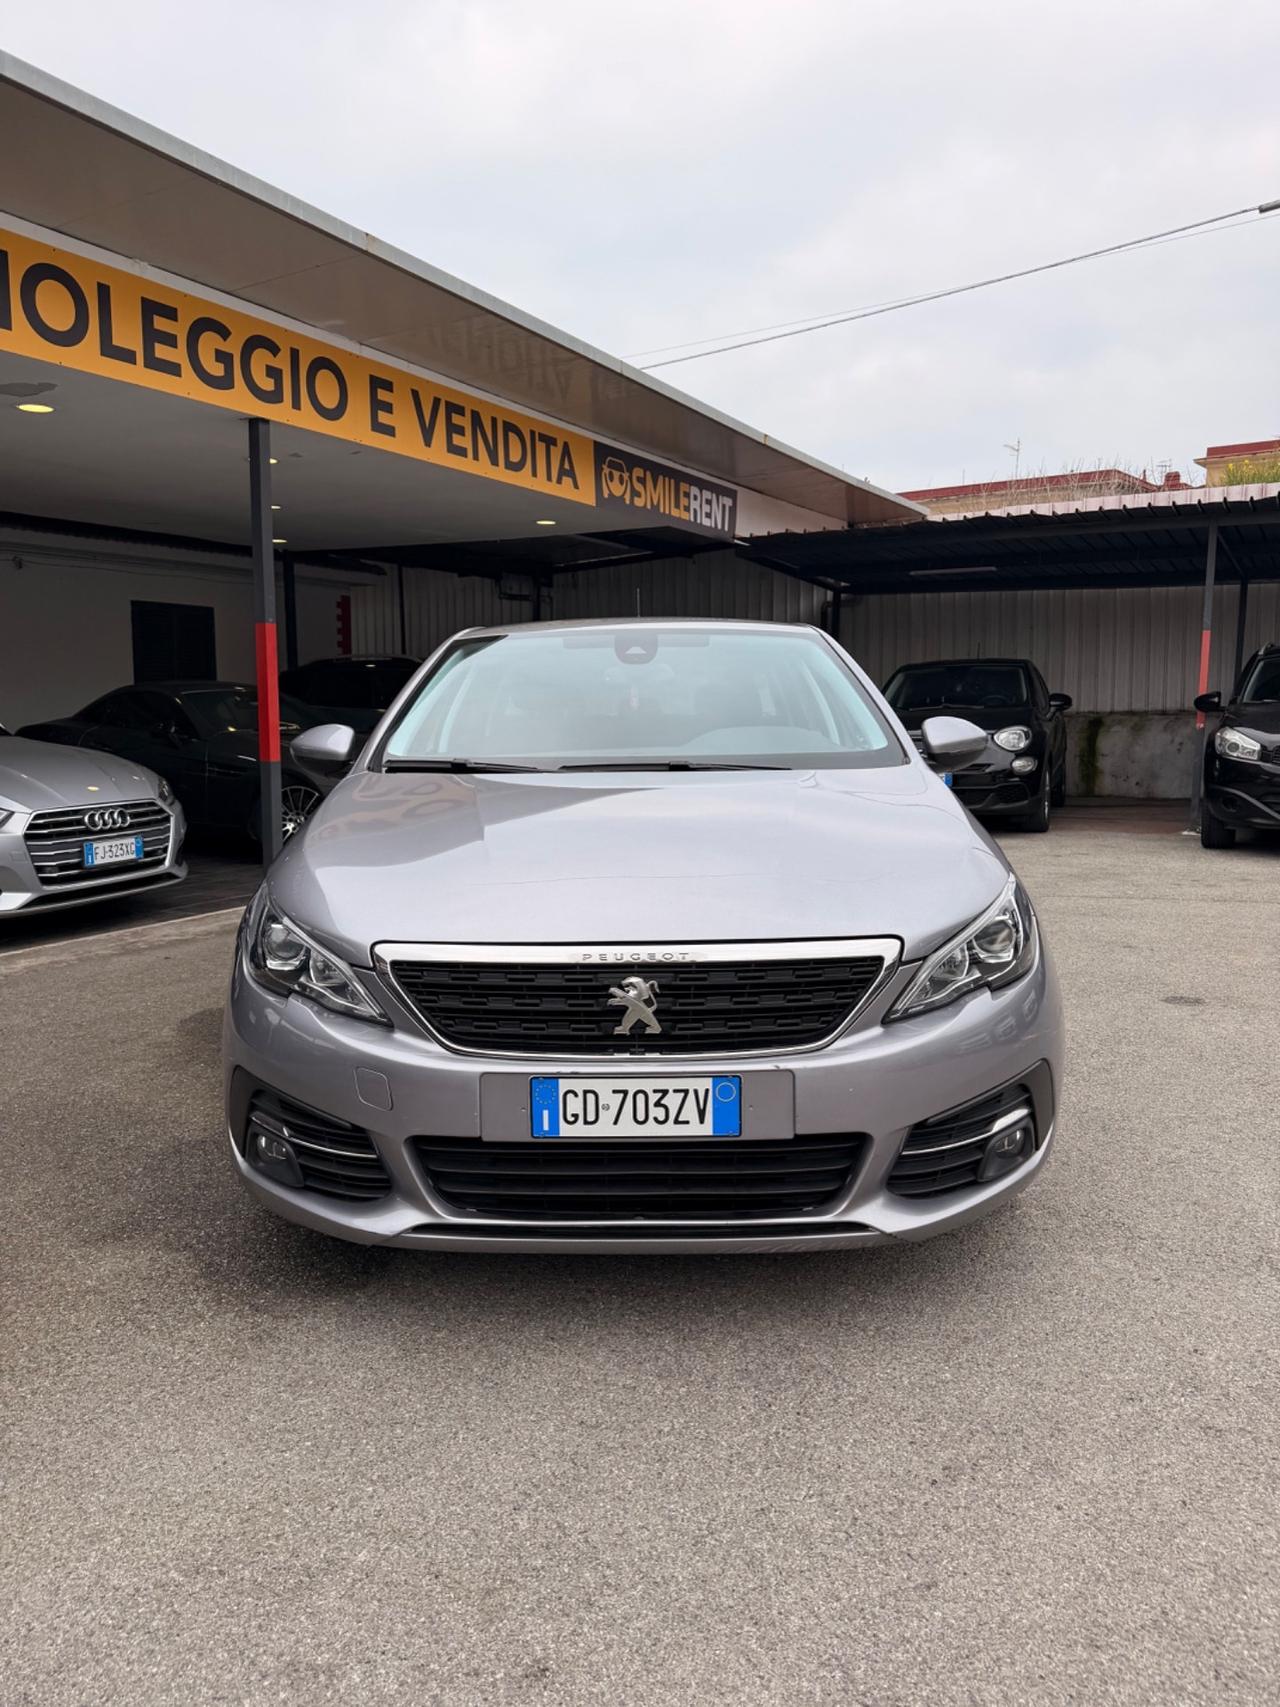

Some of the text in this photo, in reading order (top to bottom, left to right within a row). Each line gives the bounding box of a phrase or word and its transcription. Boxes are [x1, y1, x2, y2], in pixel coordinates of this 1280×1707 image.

[0, 248, 348, 422] OLEGGIO
[369, 374, 397, 438] E
[411, 388, 580, 490] VENDITA
[582, 952, 689, 961] PEUGEOT
